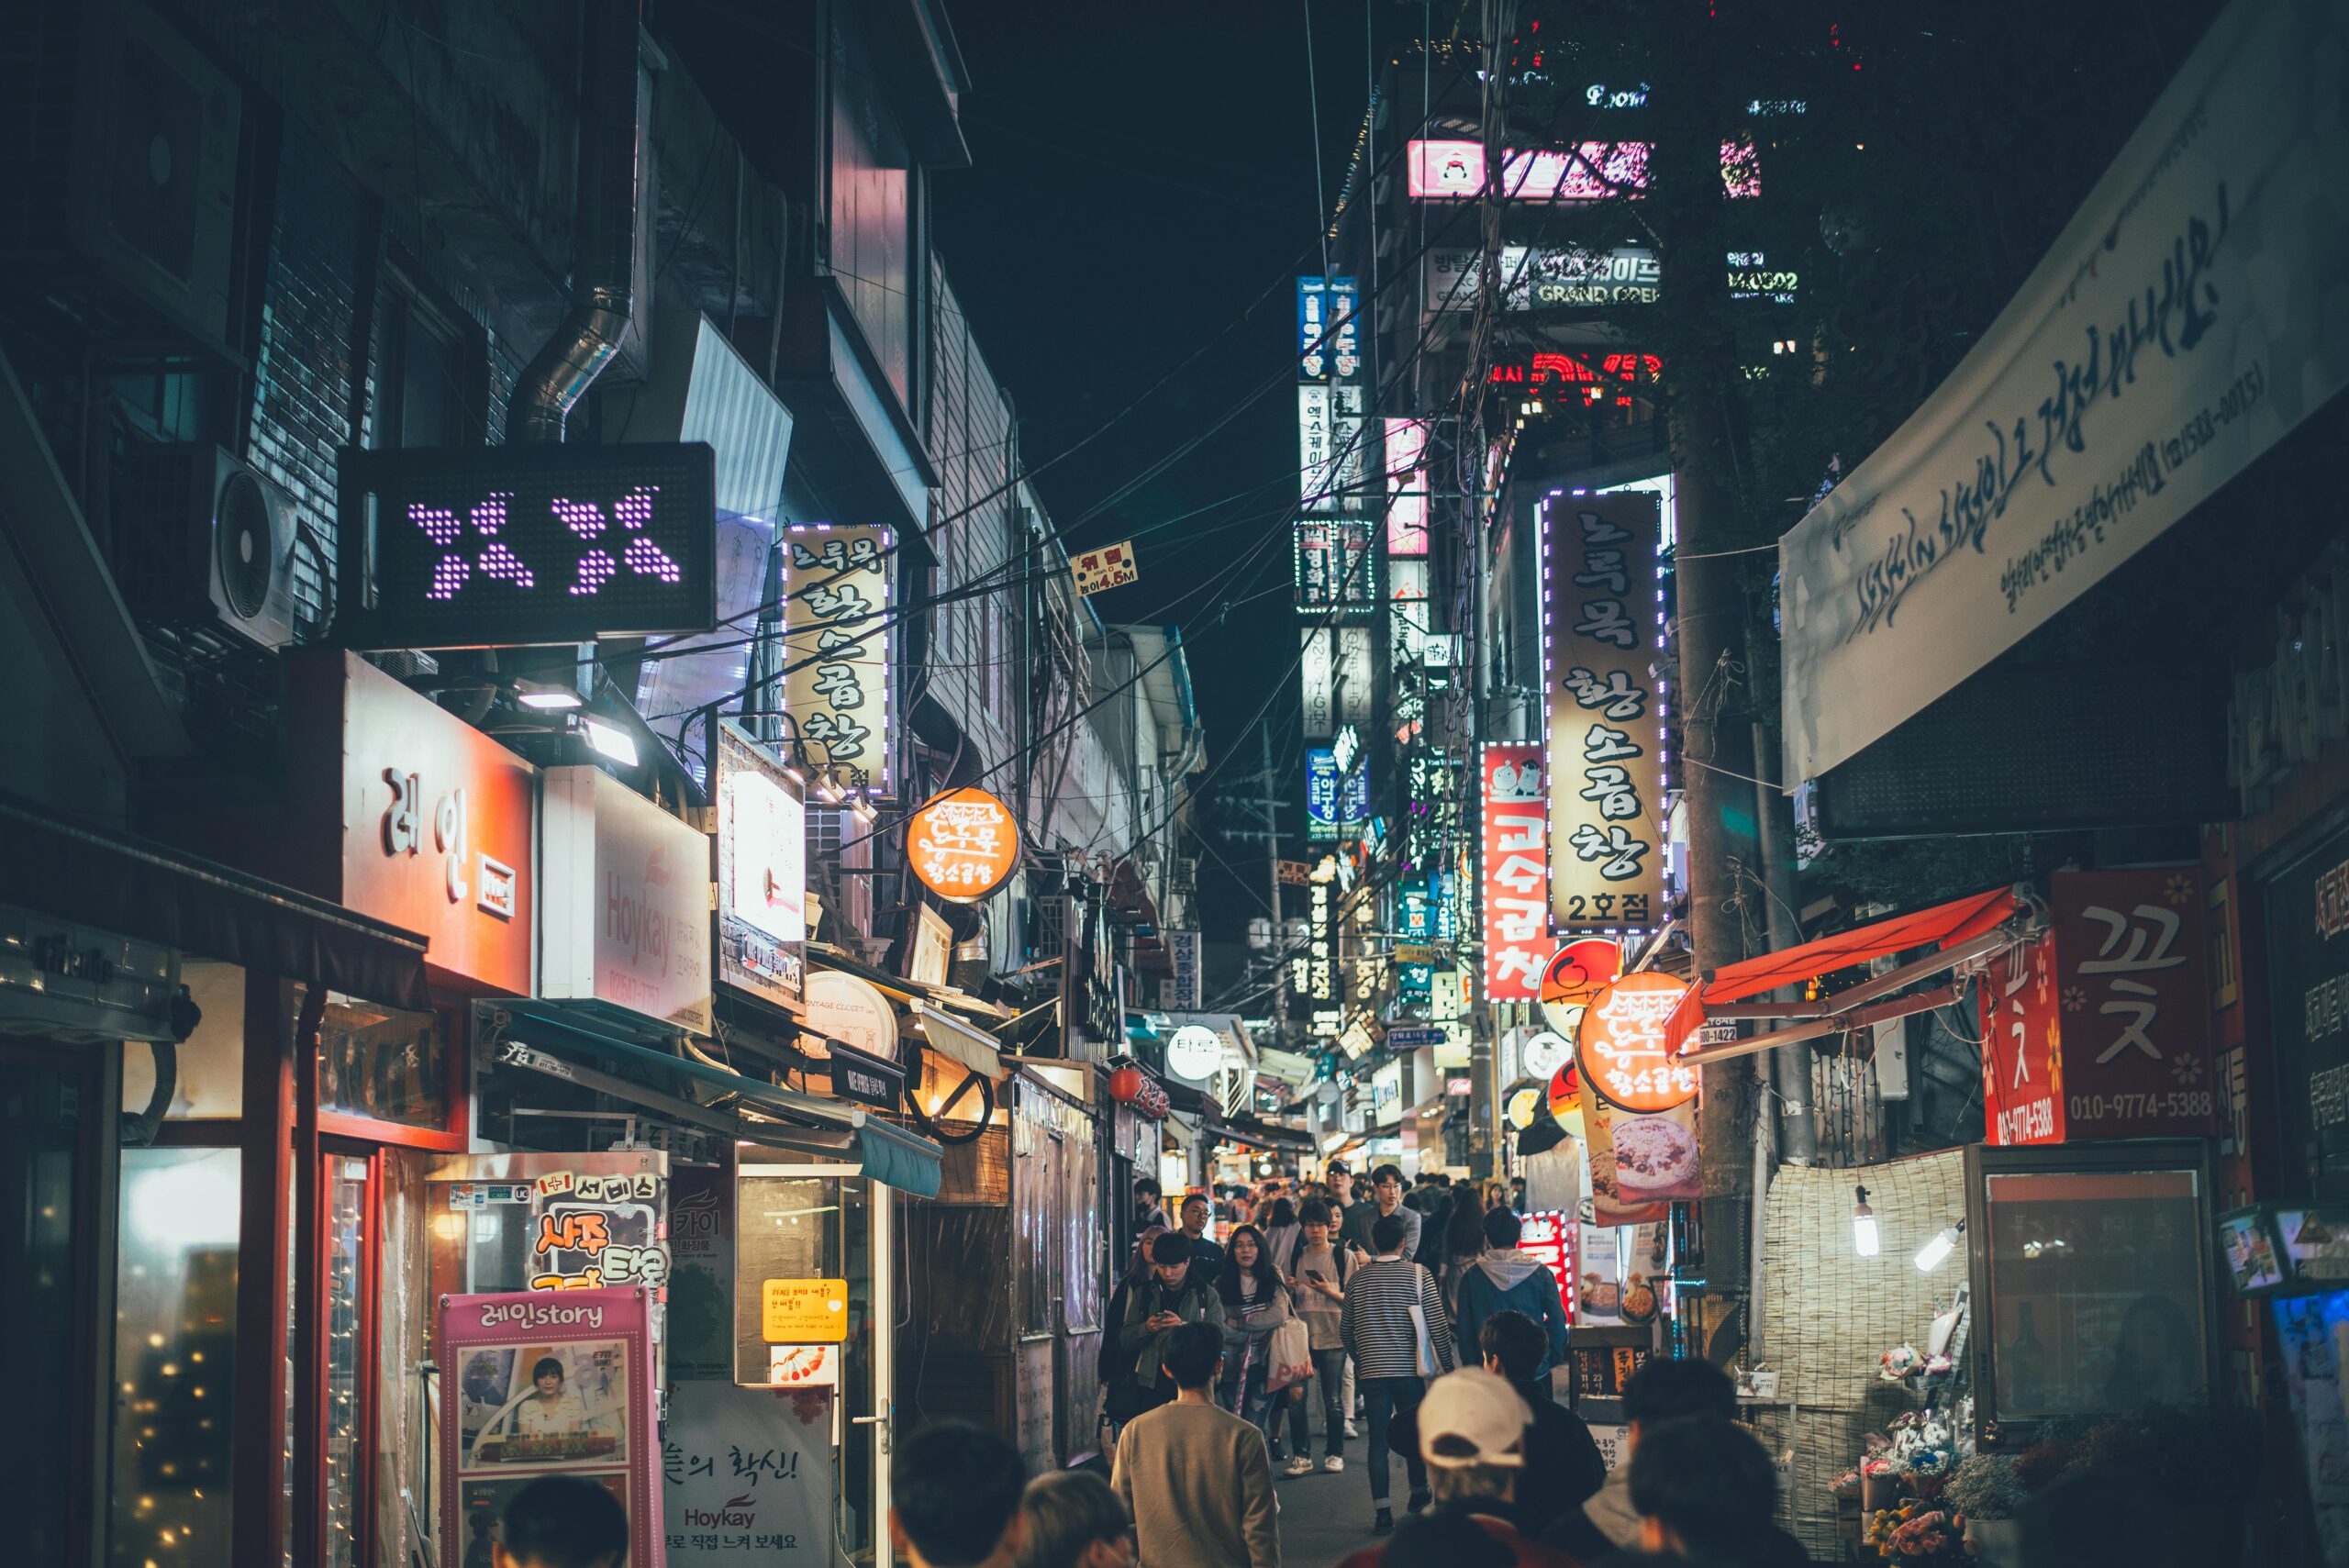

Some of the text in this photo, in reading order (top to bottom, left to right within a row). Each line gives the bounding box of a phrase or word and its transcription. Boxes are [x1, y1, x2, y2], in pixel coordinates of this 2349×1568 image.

[1081, 548, 1122, 572] 위험
[1572, 510, 1641, 651] 노루목
[791, 538, 883, 762] 노루목 황소곱창
[1562, 665, 1650, 883] 황소곱창
[379, 766, 469, 905] 레인
[923, 861, 993, 885] 황소곱창
[1567, 892, 1650, 922] 2호점
[607, 871, 671, 979] Hoykay
[1311, 960, 1330, 1000] 1929
[2076, 904, 2188, 1064] 꽃
[835, 1003, 865, 1013] CLOSET
[1177, 1038, 1213, 1053] 타로
[1605, 1067, 1696, 1097] 황소곱창
[2070, 1092, 2212, 1121] 010-9774-5388
[578, 1176, 653, 1201] 서비스
[535, 1212, 611, 1257] 사주
[681, 1239, 711, 1251] 화장품
[480, 1302, 604, 1329] 레인story
[728, 1445, 798, 1487] 확신!
[685, 1508, 755, 1529] Hoykay
[690, 1534, 718, 1550] 직접
[754, 1534, 797, 1551] 보세요
